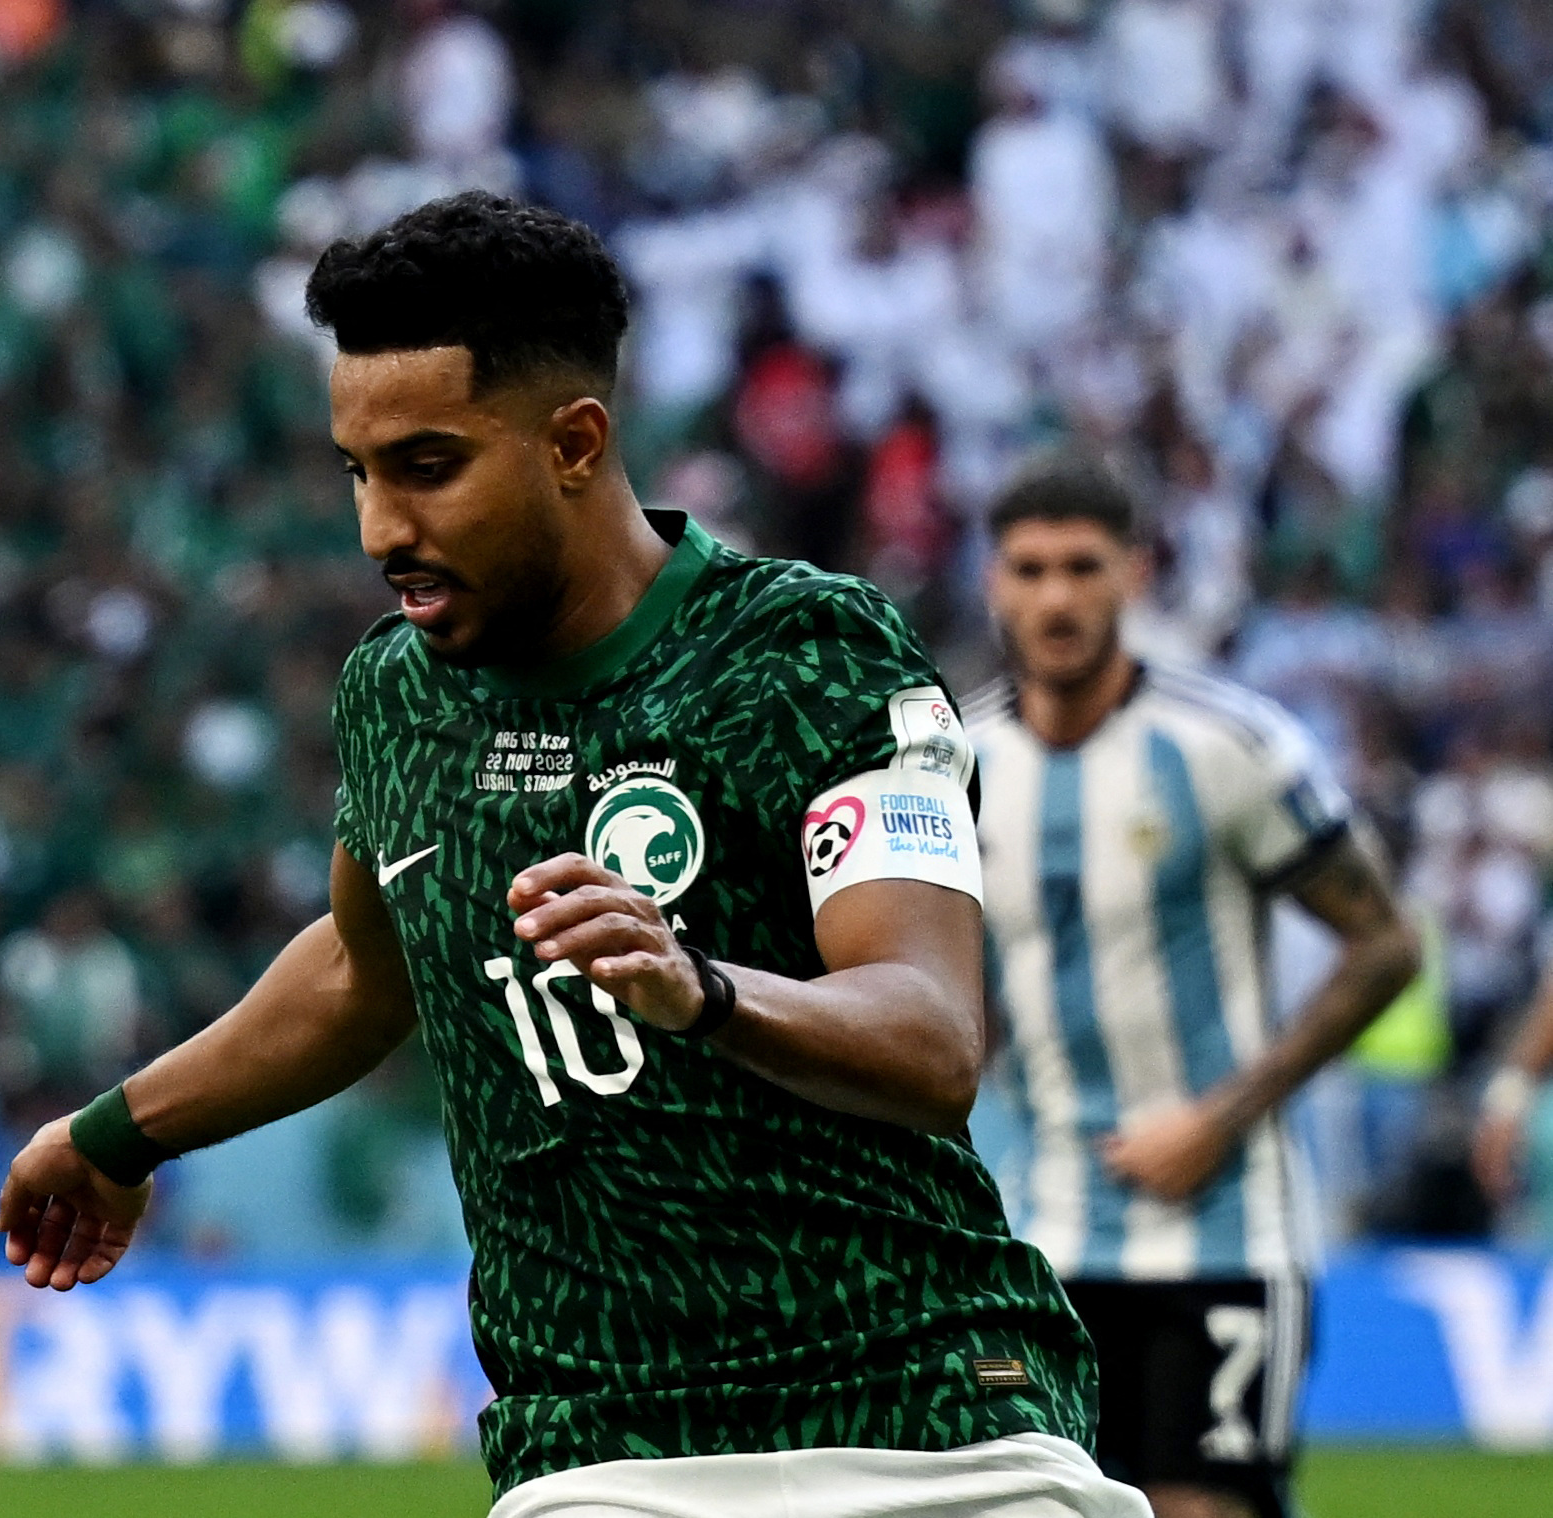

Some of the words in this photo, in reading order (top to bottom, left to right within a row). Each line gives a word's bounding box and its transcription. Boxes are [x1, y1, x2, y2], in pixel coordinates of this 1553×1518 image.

[494, 731, 519, 749] ARG
[539, 733, 570, 750] KSA
[485, 753, 501, 770] 22
[535, 753, 574, 772] 2022
[475, 772, 518, 792] LUSAIL
[586, 758, 676, 792] السعودية
[880, 794, 950, 816] FOOTBALL
[882, 812, 953, 840] UNITES
[647, 850, 683, 868] SAFF
[886, 837, 915, 853] the
[918, 839, 959, 862] World
[484, 956, 645, 1107] 10
[1199, 1304, 1267, 1462] 7
